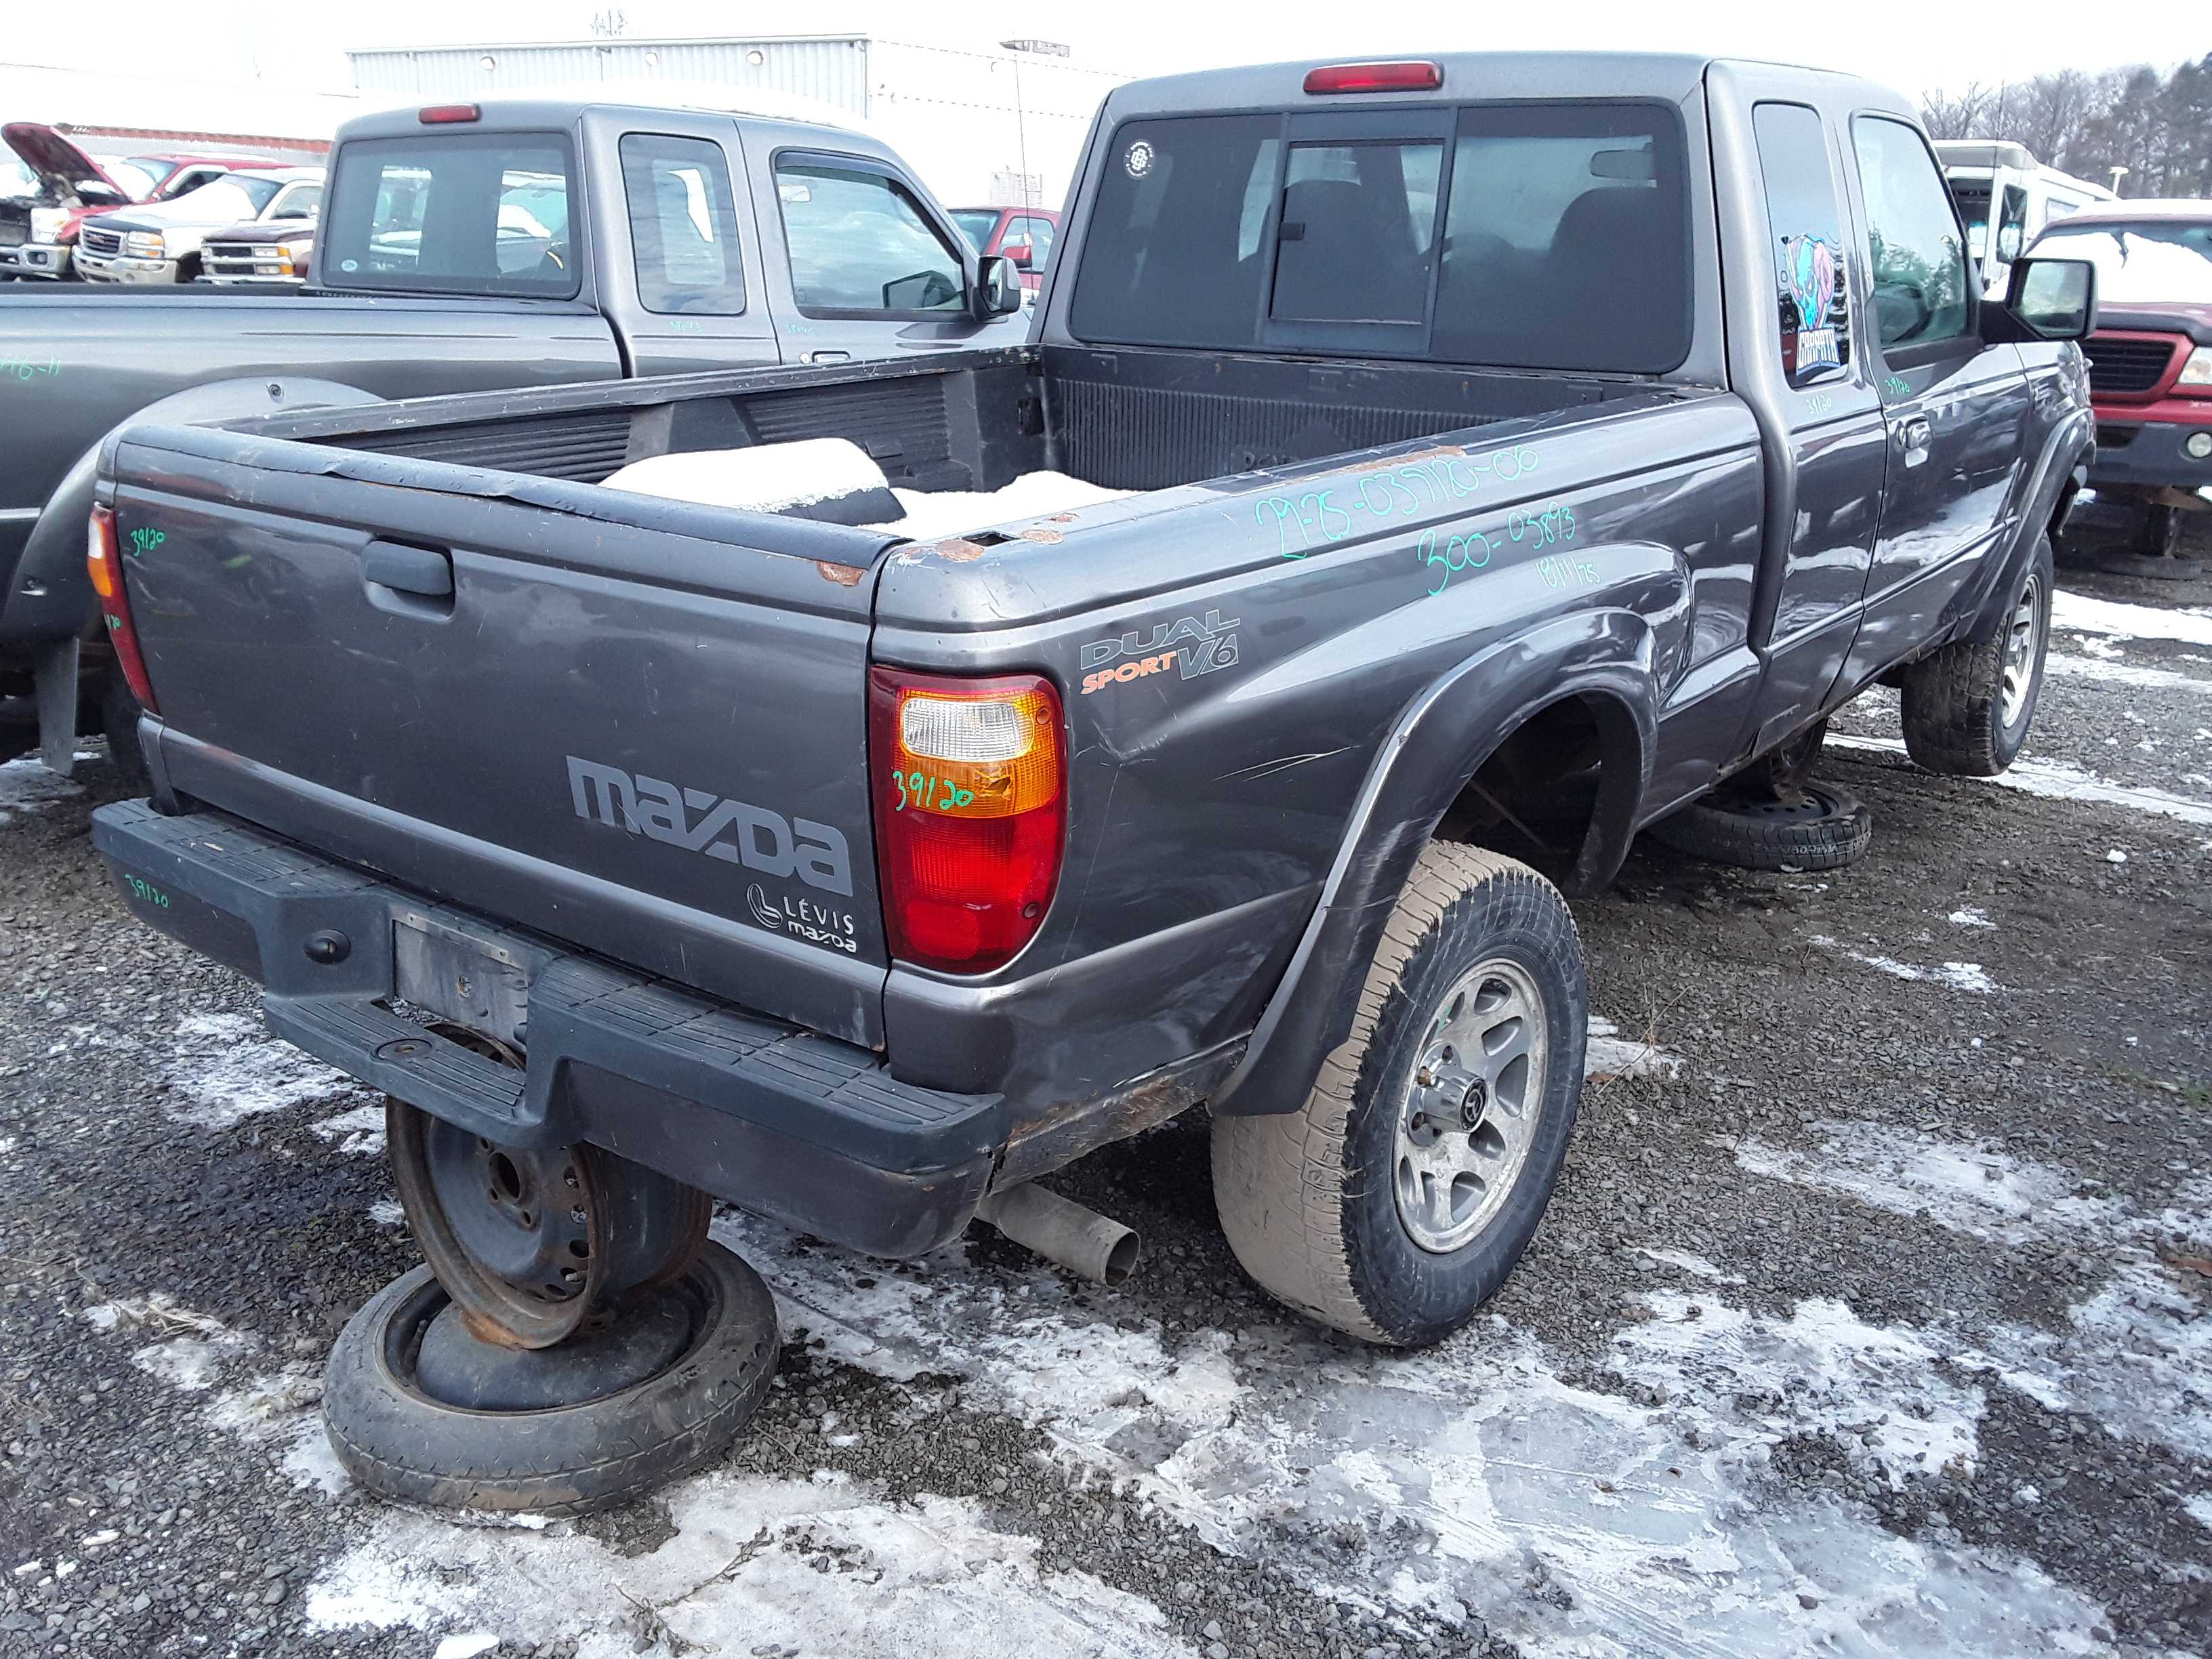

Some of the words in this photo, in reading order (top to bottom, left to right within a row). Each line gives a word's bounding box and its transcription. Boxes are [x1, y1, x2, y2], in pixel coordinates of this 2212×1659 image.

[130, 527, 166, 557] 39120
[1417, 501, 1576, 596] 300-03893
[1080, 609, 1241, 670] DUAL
[1080, 650, 1178, 695] SPORT
[1177, 633, 1240, 681] V6
[892, 771, 975, 811] 39120
[124, 874, 169, 909] 39120
[783, 896, 855, 935] LÉVIS
